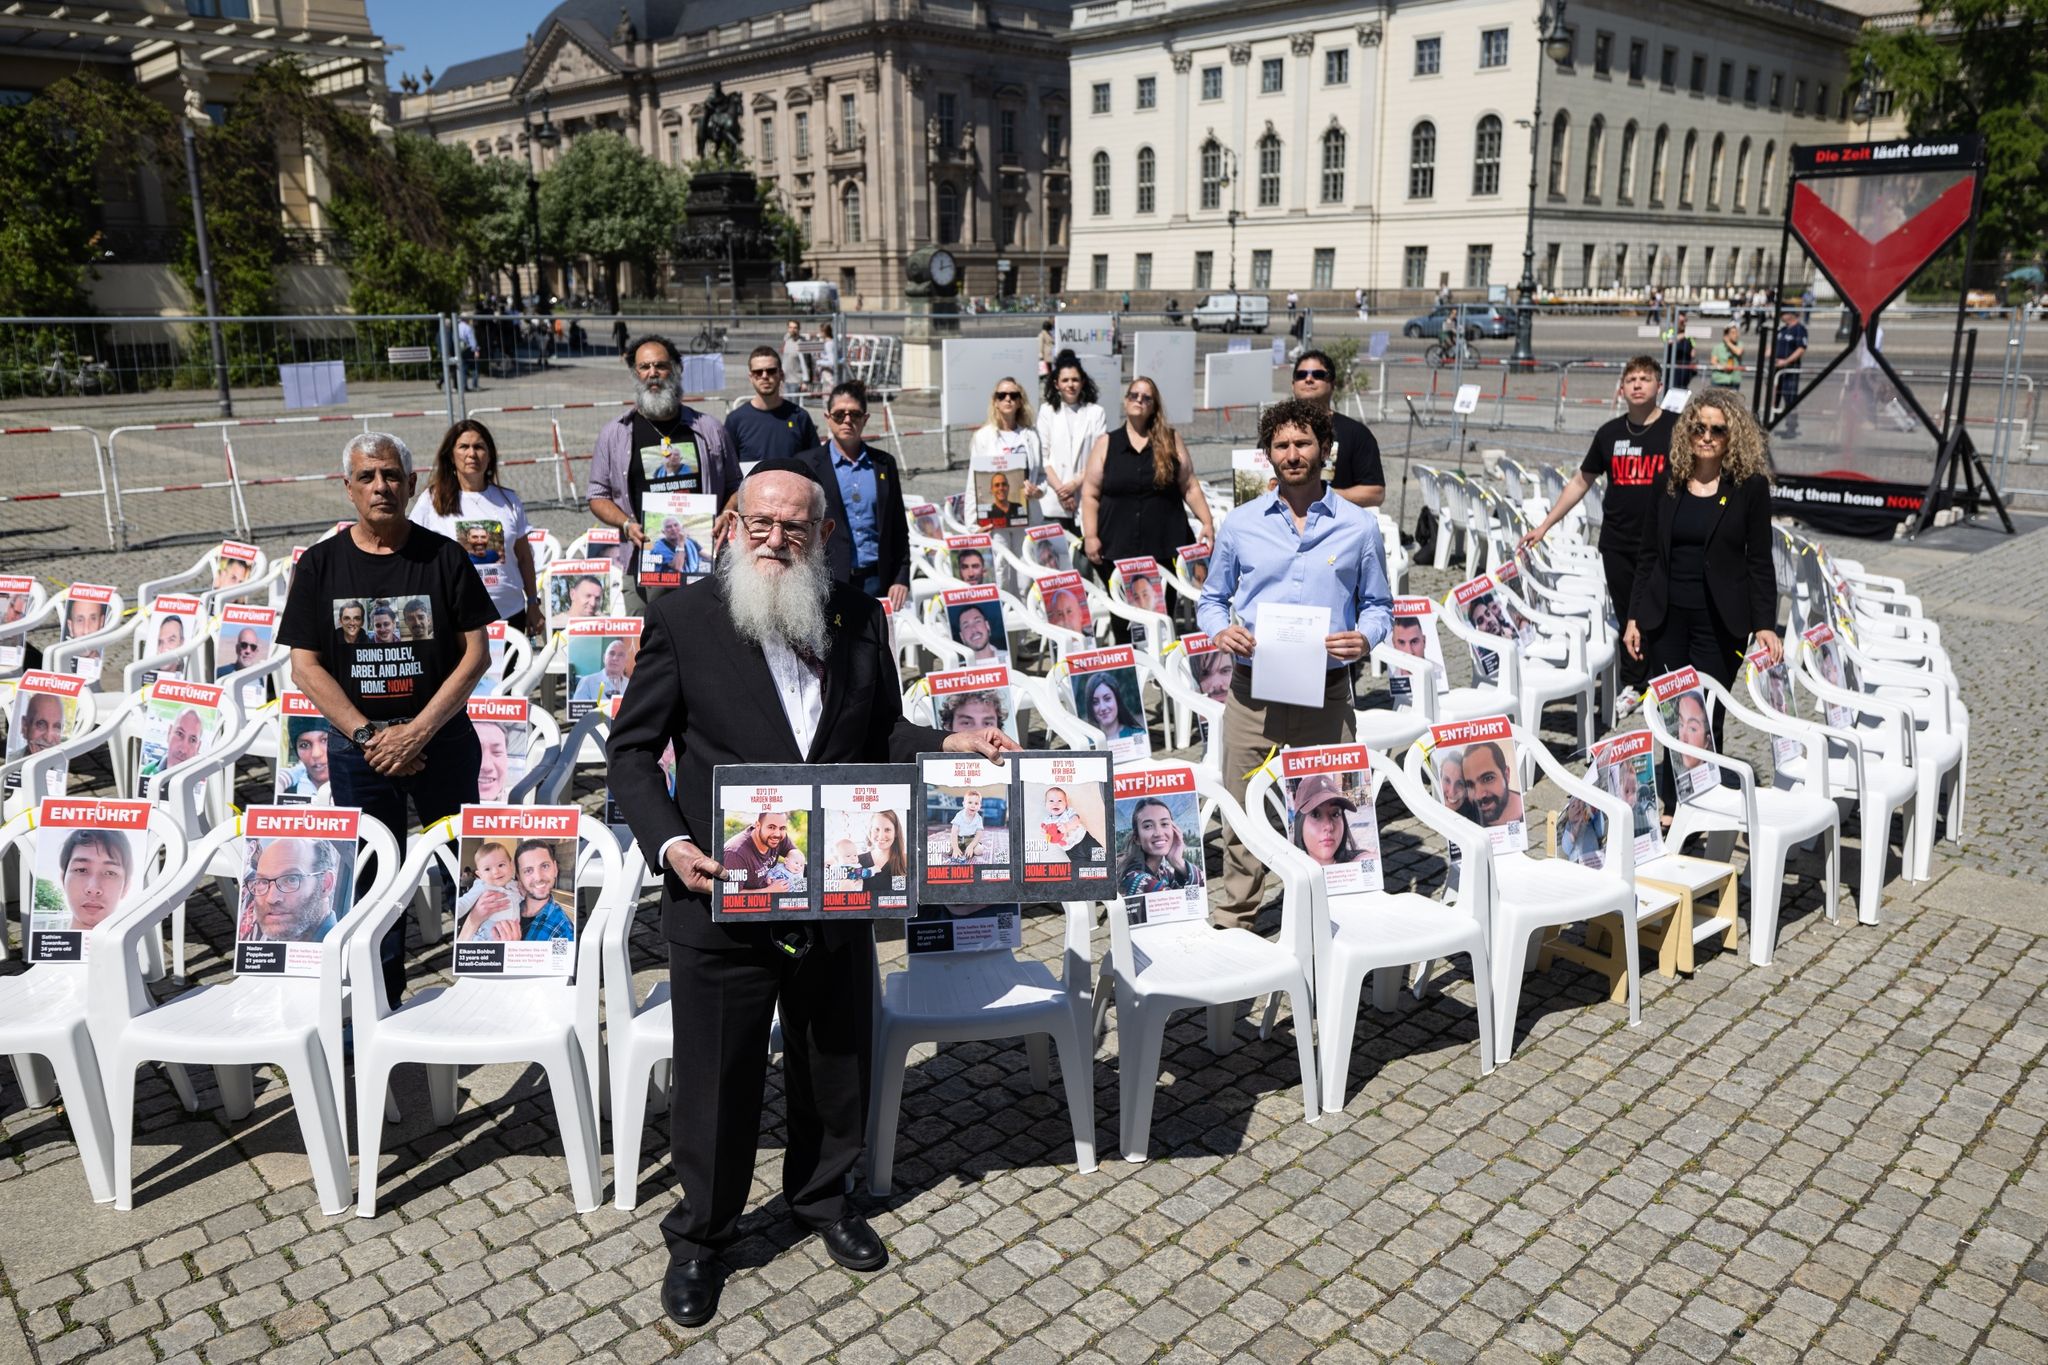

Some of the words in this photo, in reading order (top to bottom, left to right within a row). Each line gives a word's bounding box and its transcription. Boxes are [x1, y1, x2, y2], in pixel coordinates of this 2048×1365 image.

[1816, 150, 1839, 162] Die
[1841, 147, 1871, 161] Zeit
[1873, 144, 1909, 159] läuft
[1912, 143, 1958, 157] davon
[1060, 328, 1082, 342] WALL
[1806, 488, 1841, 503] them
[1844, 492, 1884, 507] home
[591, 532, 619, 541] ENTFÜ
[950, 537, 988, 546] ENTFÜHRT
[224, 544, 257, 559] ENTFÜHRT
[1121, 559, 1155, 571] ENTFÜHRT
[0, 580, 30, 589] NTFÜHRT
[1041, 575, 1078, 589] ENTFÜHRT
[1458, 579, 1490, 599] ENTFÜHRT
[72, 585, 109, 599] ENTFÜHRT
[947, 589, 994, 601] ENTFÜHRT
[159, 600, 196, 612] ENTFÜHRT
[226, 610, 271, 622] ENTFÜHRT
[356, 649, 383, 662] BRING
[384, 647, 415, 661] DOLEV,
[1073, 651, 1128, 668] ENTFÜHRT
[351, 664, 377, 678] ARBEL
[379, 663, 397, 677] AND
[399, 661, 423, 676] ARIEL
[24, 675, 78, 691] ENTFÜHRT
[361, 680, 386, 693] HOME
[387, 677, 413, 692] NOW!
[936, 672, 1001, 689] ENTFÜHRT
[1658, 674, 1695, 699] ENTFÜHRT
[158, 683, 216, 701] ENTFÜHRT
[468, 700, 521, 715] TFÜHRT
[1440, 722, 1503, 741] ENTFÜHRT
[1288, 753, 1360, 770] ENTFÜHRT
[50, 804, 141, 823] ENTFÜHRT
[256, 813, 350, 832] ENTFÜHRT
[472, 813, 569, 829] ENTFÜHRT
[928, 841, 950, 853] BRING
[1026, 840, 1048, 851] BRING
[928, 854, 942, 865] HIM
[1026, 852, 1040, 863] HIM
[824, 868, 848, 880] BRING
[928, 867, 949, 878] HOME
[951, 865, 973, 878] NOW!
[1025, 865, 1047, 876] HOME
[1049, 863, 1070, 876] NOW!
[723, 882, 739, 894] HIM
[824, 881, 839, 892] HER
[723, 896, 746, 907] HOME
[748, 893, 771, 907] NOW!
[824, 893, 846, 905] HOME
[848, 891, 871, 905] NOW!
